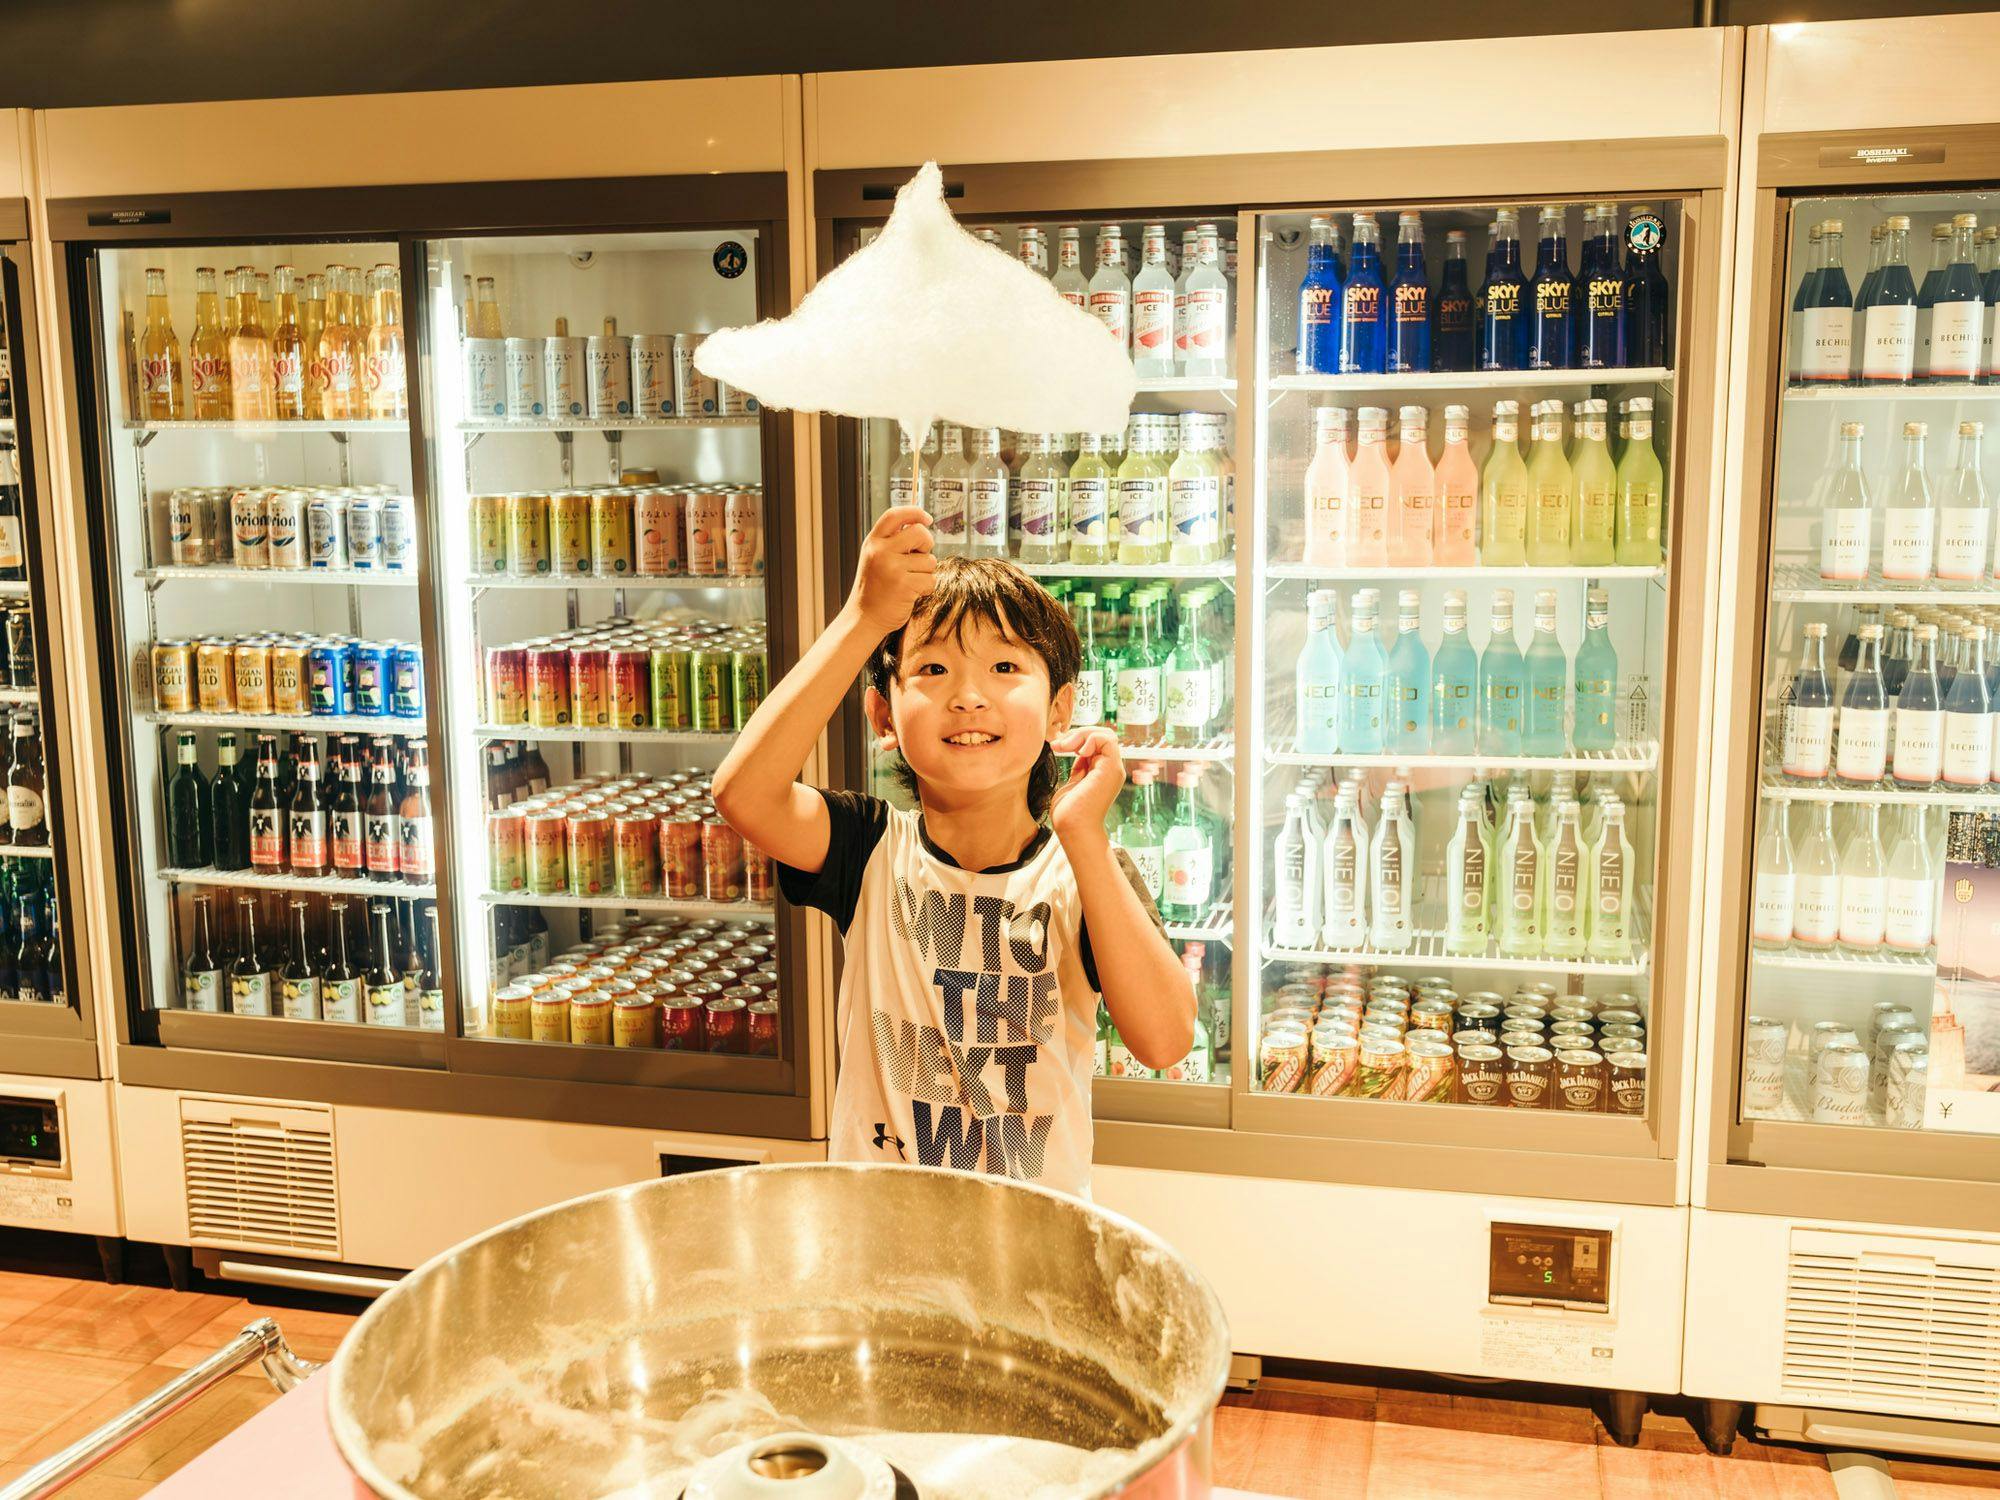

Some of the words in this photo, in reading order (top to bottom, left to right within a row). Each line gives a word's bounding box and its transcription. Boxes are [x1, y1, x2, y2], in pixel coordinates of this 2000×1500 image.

[1857, 148, 1908, 157] HOSHIZAKI
[1348, 286, 1379, 302] SKYY
[1395, 285, 1427, 301] SKYY
[1487, 283, 1521, 300] SKYY
[1536, 281, 1571, 297] SKYY
[1588, 279, 1623, 296] SKYY
[1302, 288, 1333, 303] SKYY
[1588, 295, 1622, 309] BLUE
[1347, 301, 1378, 314] BLUE
[1395, 300, 1426, 314] BLUE
[1440, 299, 1469, 313] SKYY
[1487, 299, 1520, 313] BLUE
[1536, 297, 1570, 311] BLUE
[235, 510, 270, 526] Orion
[1134, 677, 1157, 712] 참이슬
[933, 968, 1061, 1046] THE
[873, 1007, 1038, 1118] NEXT
[1461, 1072, 1480, 1085] JACK
[1559, 1077, 1577, 1089] JACK
[1611, 1080, 1629, 1093] JACK
[1940, 1101, 1954, 1119] ¥
[31, 1134, 38, 1146] 5
[912, 1099, 1056, 1181] WIN
[1543, 1270, 1553, 1284] 5
